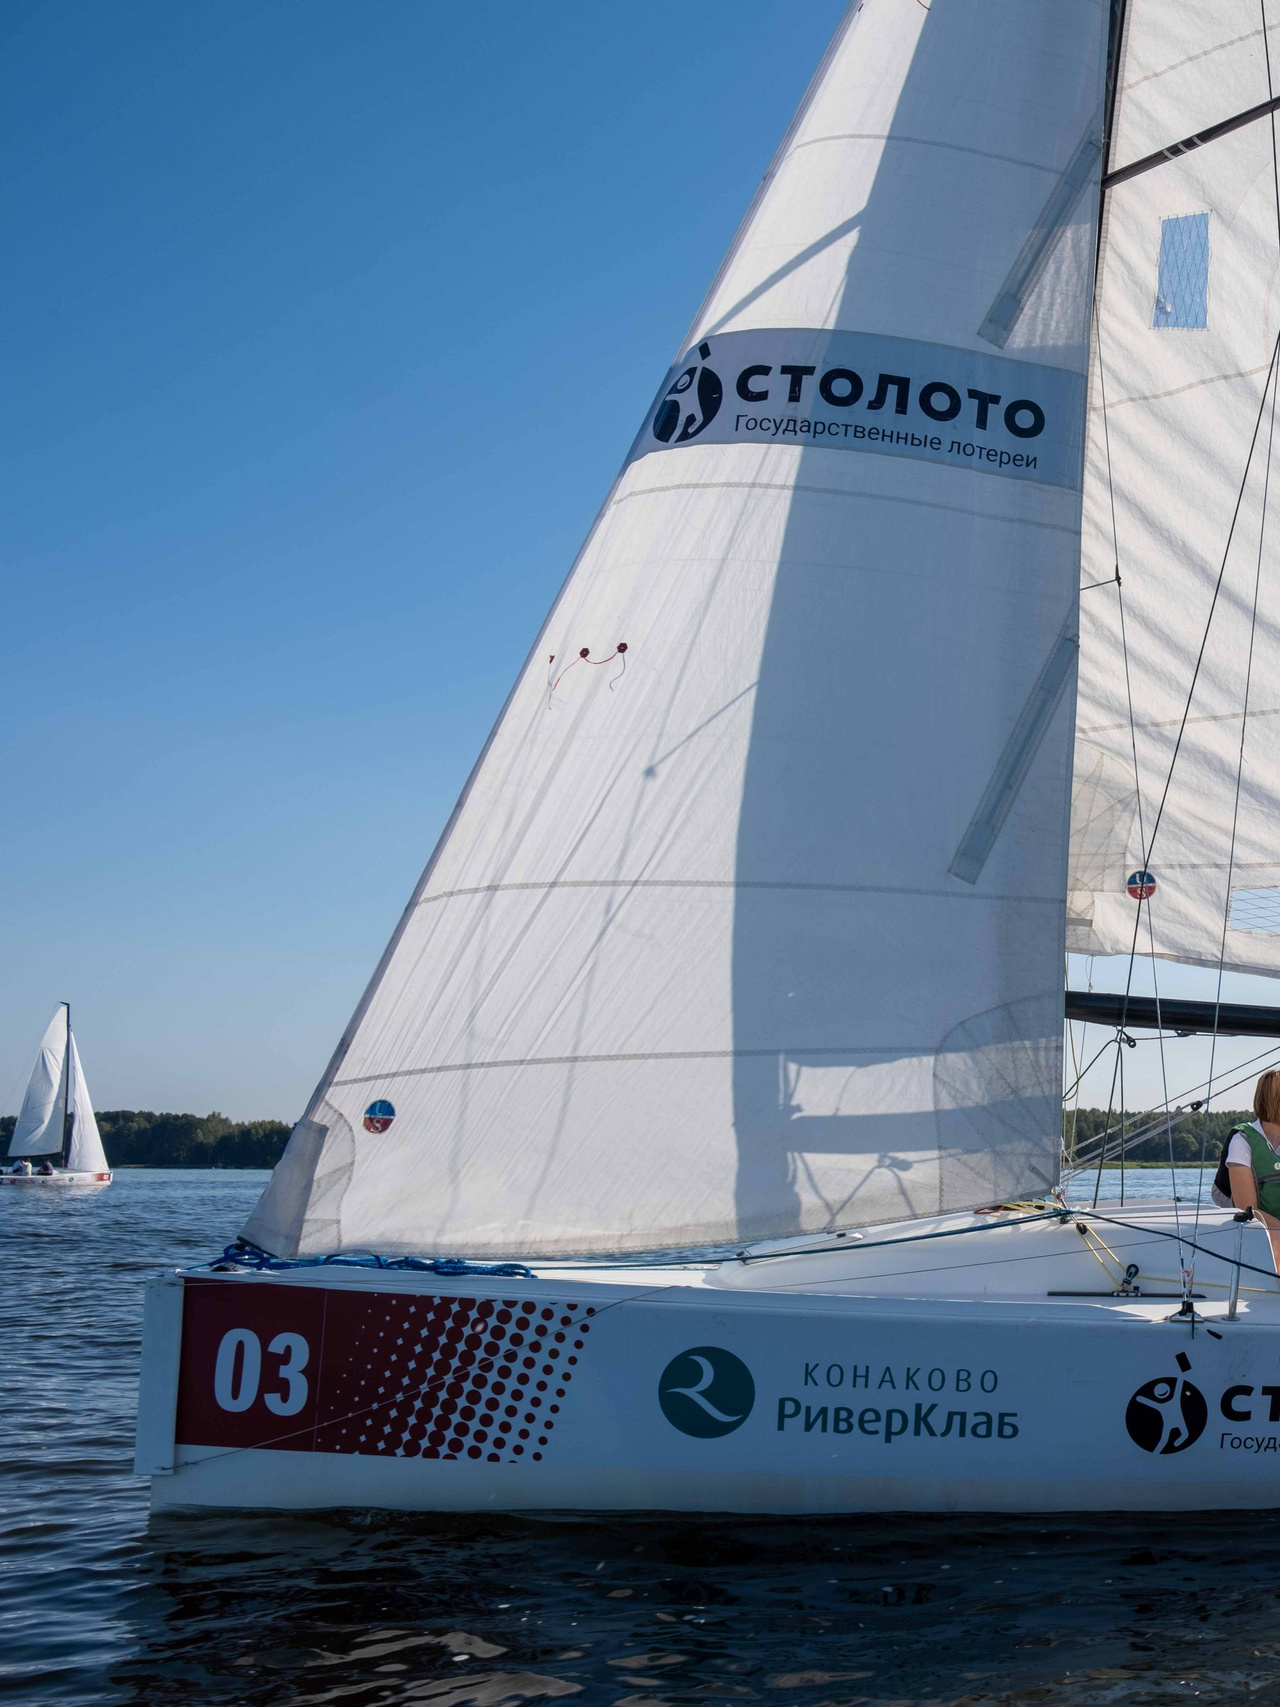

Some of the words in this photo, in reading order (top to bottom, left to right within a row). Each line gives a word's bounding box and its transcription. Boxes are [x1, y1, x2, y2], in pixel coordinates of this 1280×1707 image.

[735, 363, 1046, 439] СТОЛОТО
[734, 413, 942, 452] Государственные
[947, 438, 1039, 470] лотереи
[213, 1327, 311, 1417] 03
[803, 1362, 999, 1394] КОНАКОВО
[776, 1396, 1020, 1444] РиверКлаб
